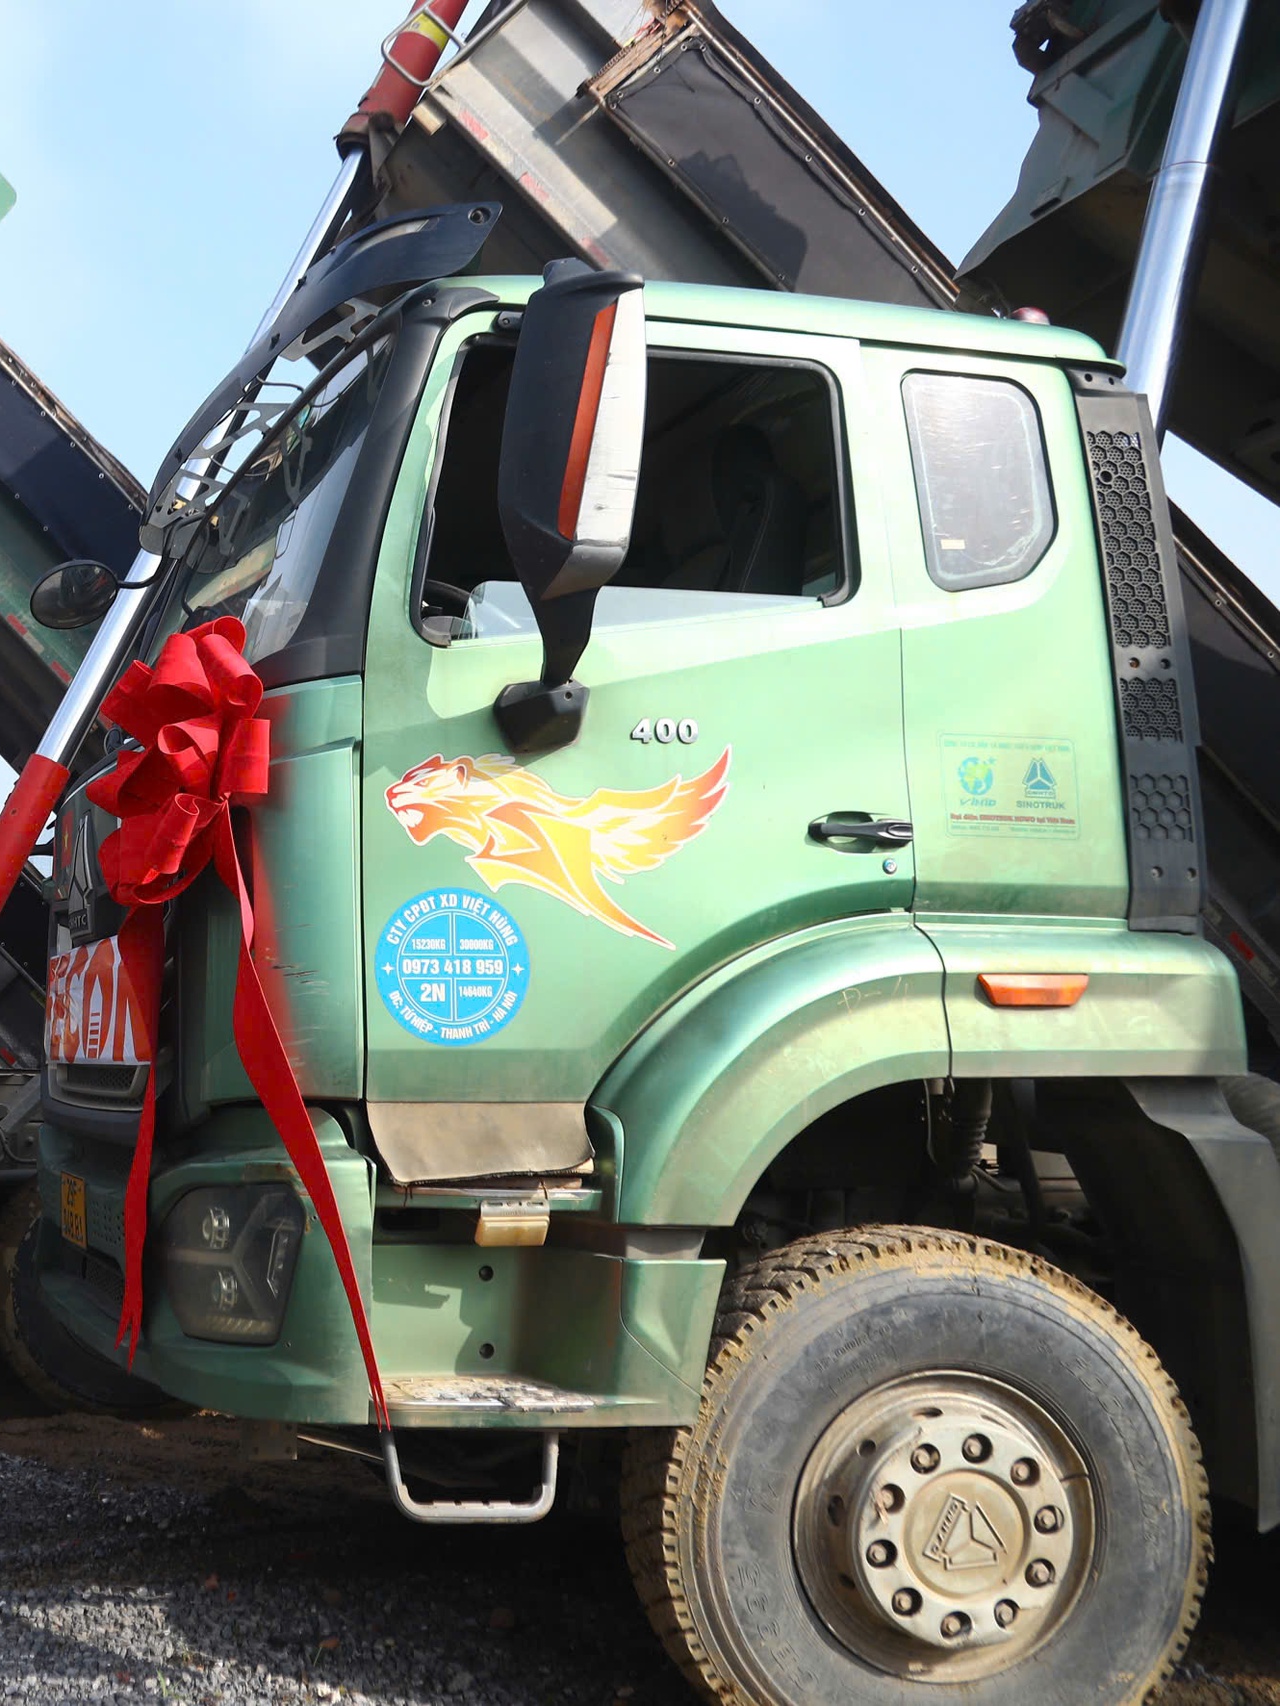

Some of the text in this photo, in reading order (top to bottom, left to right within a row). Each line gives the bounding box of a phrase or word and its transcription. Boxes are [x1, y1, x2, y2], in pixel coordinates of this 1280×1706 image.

[630, 718, 699, 744] 400
[1016, 800, 1066, 810] SINOTRUK
[386, 919, 407, 946] CTY
[403, 896, 437, 923] CPĐT
[439, 893, 458, 908] XD
[462, 895, 491, 916] VIỆT
[402, 959, 504, 974] 0973 418 959
[420, 983, 446, 1002] 2N
[440, 1026, 474, 1039] THANH
